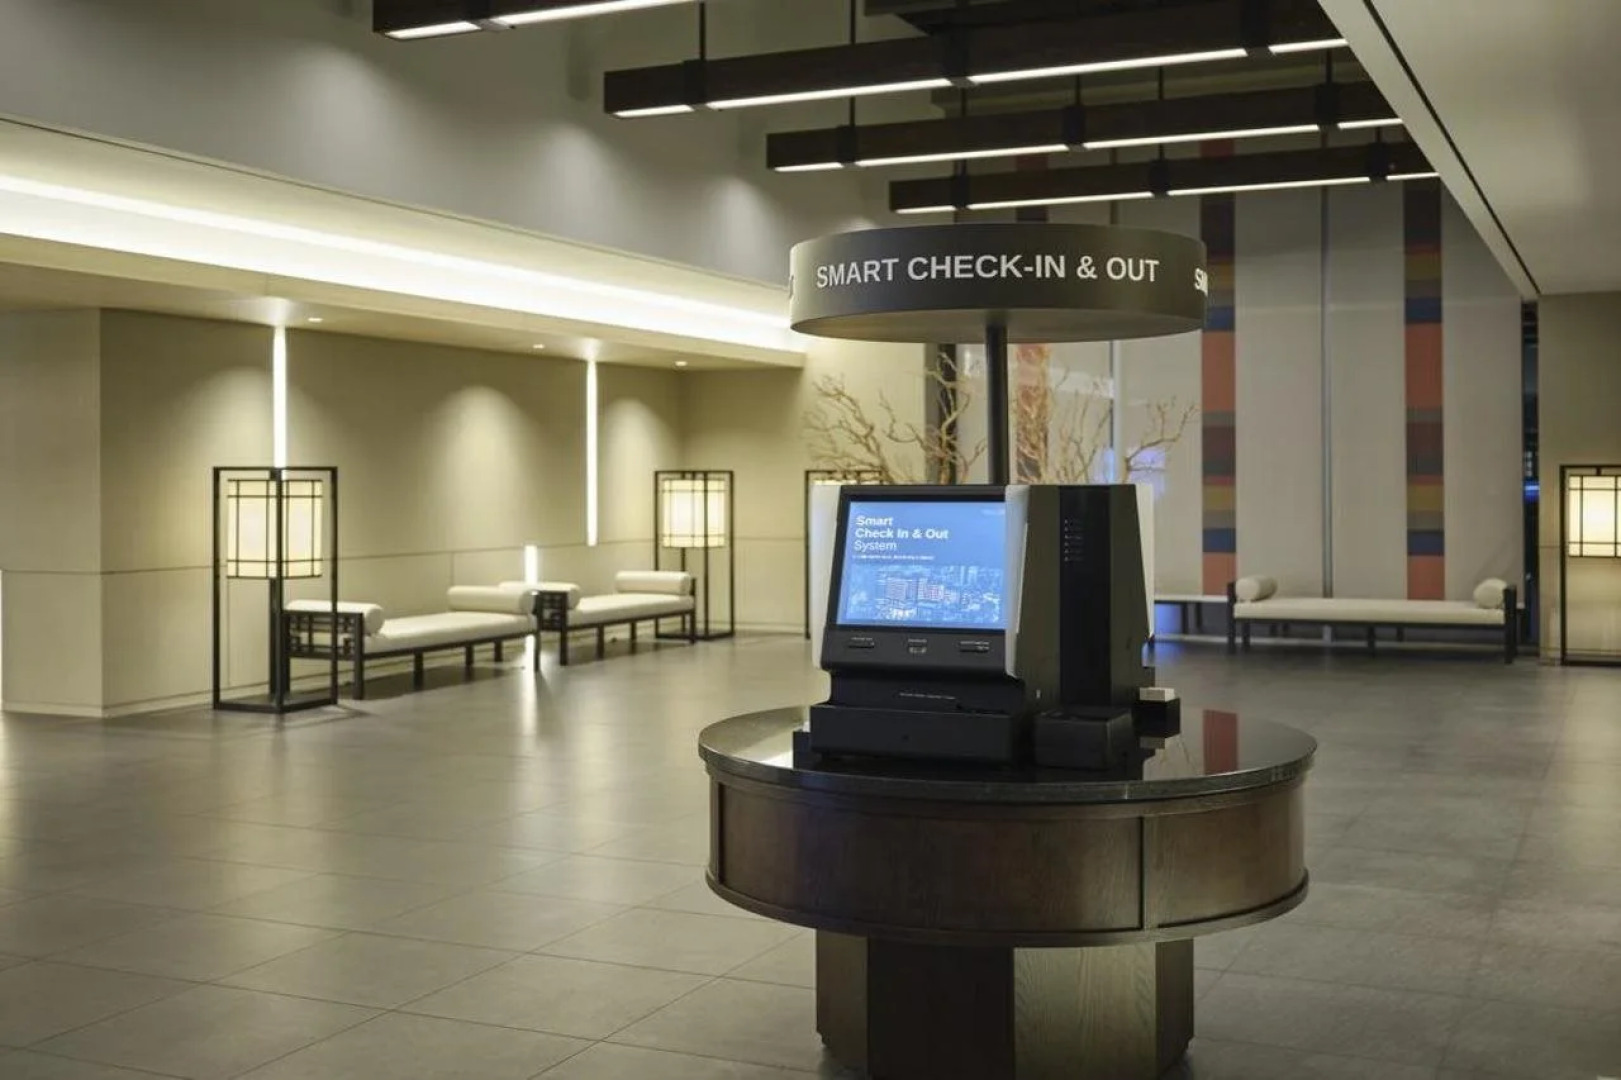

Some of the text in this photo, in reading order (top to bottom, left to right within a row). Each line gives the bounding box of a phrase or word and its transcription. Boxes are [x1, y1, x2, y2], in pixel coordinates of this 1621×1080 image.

[816, 254, 1160, 288] SMART CHECK-IN & OUT
[855, 515, 894, 526] Smart
[855, 528, 949, 540] Check In & Out
[854, 540, 897, 553] System
